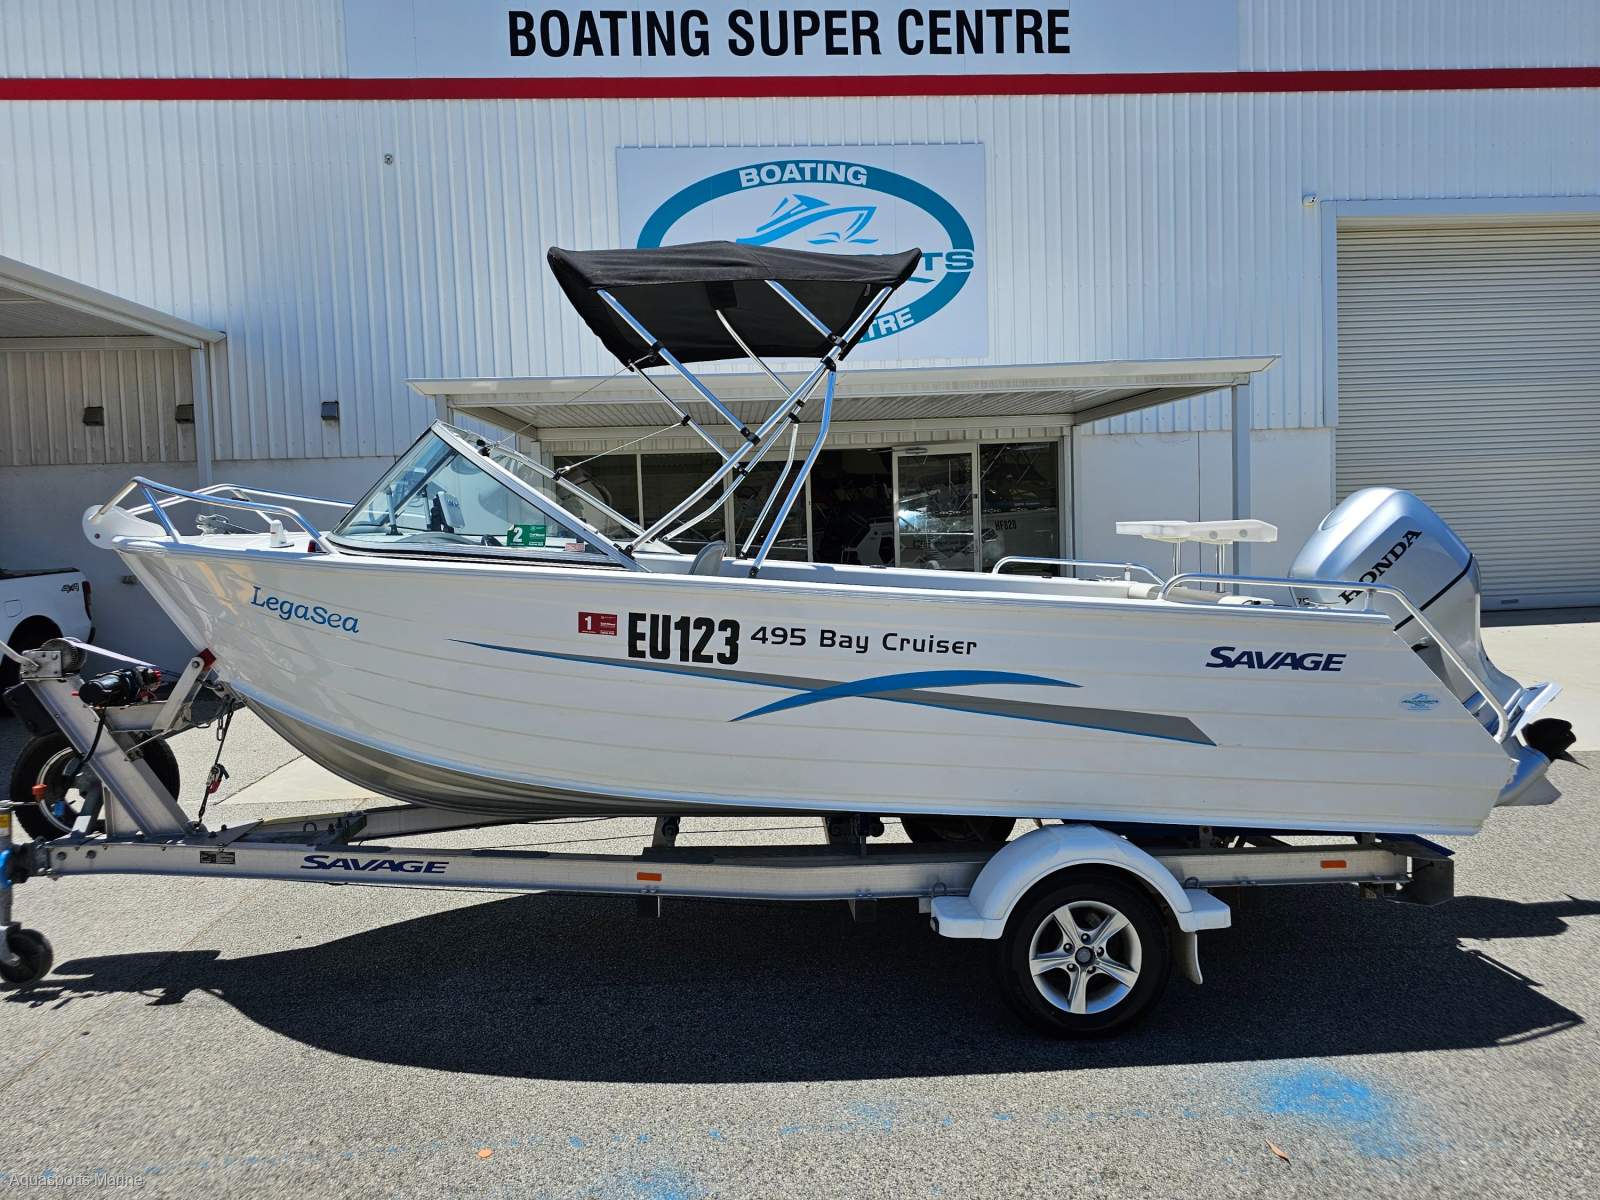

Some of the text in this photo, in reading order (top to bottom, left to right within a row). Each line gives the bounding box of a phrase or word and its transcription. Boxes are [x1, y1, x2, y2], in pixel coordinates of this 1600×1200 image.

[508, 8, 1071, 57] BOATING SUPER CENTRE
[739, 162, 868, 188] BOATING
[512, 526, 523, 543] 2
[251, 585, 360, 634] LegaSea
[584, 615, 592, 631] 1
[628, 612, 740, 665] EU123
[750, 626, 978, 656] 495 Bay Cruiser
[1205, 646, 1348, 672] SAVAGE
[300, 854, 449, 874] SAVAGE
